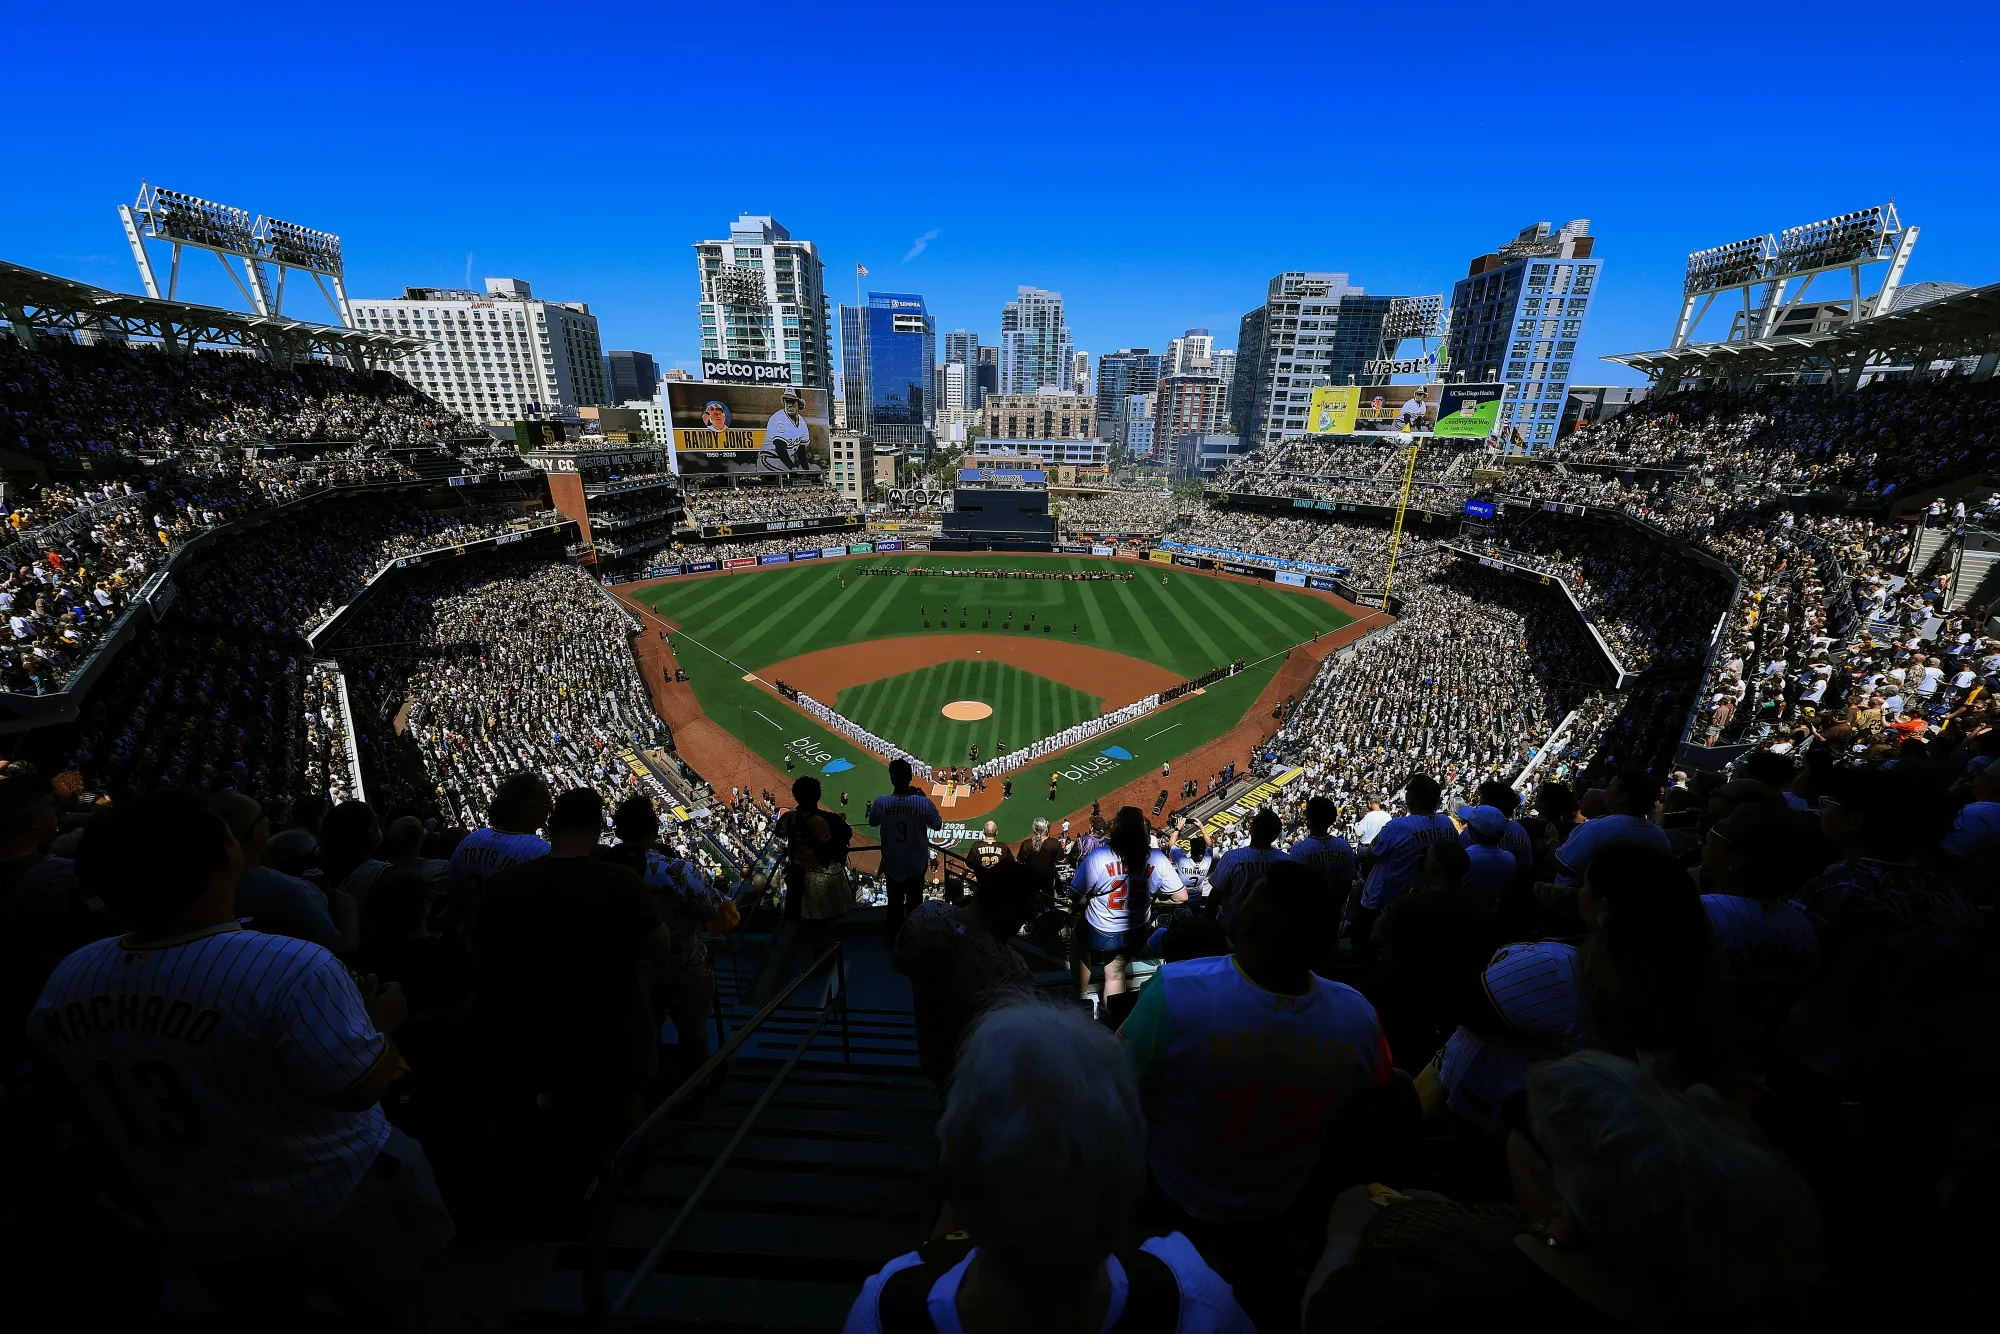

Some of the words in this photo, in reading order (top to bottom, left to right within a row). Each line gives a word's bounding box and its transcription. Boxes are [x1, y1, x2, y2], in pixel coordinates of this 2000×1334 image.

[704, 361, 752, 378] petco
[754, 366, 790, 381] park
[1368, 358, 1420, 374] Viasat
[684, 430, 718, 448] RANDY
[724, 430, 754, 448] JONES
[558, 459, 578, 472] CO.
[579, 456, 611, 469] WESTERN
[612, 454, 632, 466] METAL
[632, 452, 654, 463] SUPPLY
[906, 489, 950, 505] razr
[1293, 500, 1314, 508] RANDY
[1315, 501, 1336, 511] JONES
[714, 525, 733, 536] 35
[766, 522, 786, 530] RANDY
[787, 520, 804, 528] JONES
[844, 515, 858, 526] 35
[791, 736, 832, 762] blue
[1057, 756, 1112, 781] blue
[1078, 762, 1121, 784] CALIFORNIA
[896, 820, 908, 843] 3
[944, 822, 965, 830] 2026
[1414, 828, 1442, 845] TATIS
[978, 846, 994, 855] TATIS
[1307, 850, 1334, 865] TATIS
[1188, 876, 1199, 888] 3
[45, 994, 222, 1046] MACHADO
[1208, 1030, 1358, 1076] MACHADO
[90, 1058, 203, 1146] 13
[1216, 1082, 1338, 1149] 13
